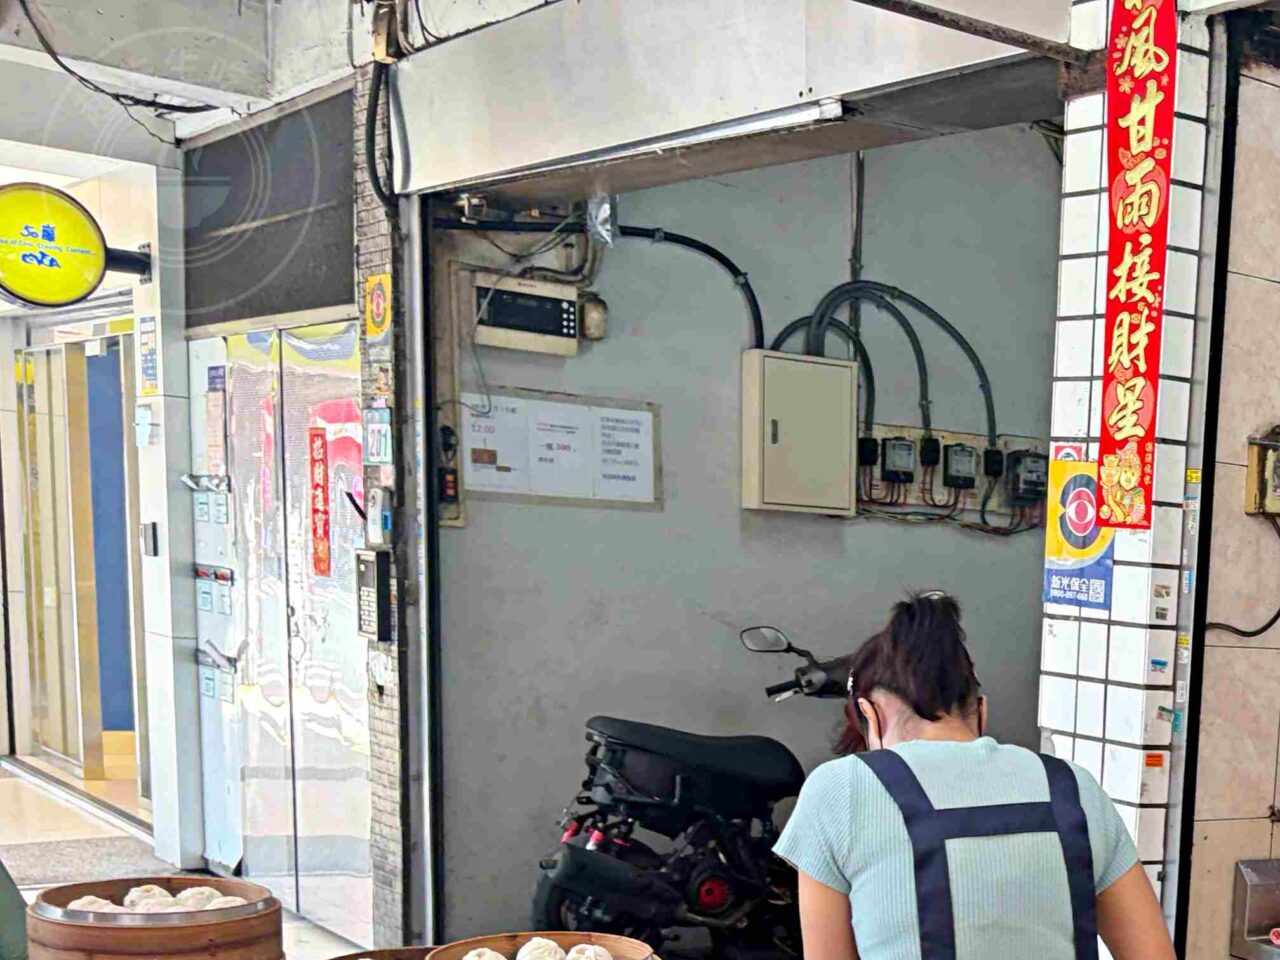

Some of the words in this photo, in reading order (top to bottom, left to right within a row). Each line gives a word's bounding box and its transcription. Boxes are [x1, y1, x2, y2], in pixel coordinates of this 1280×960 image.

[1108, 0, 1169, 441] 風甘雨接財星
